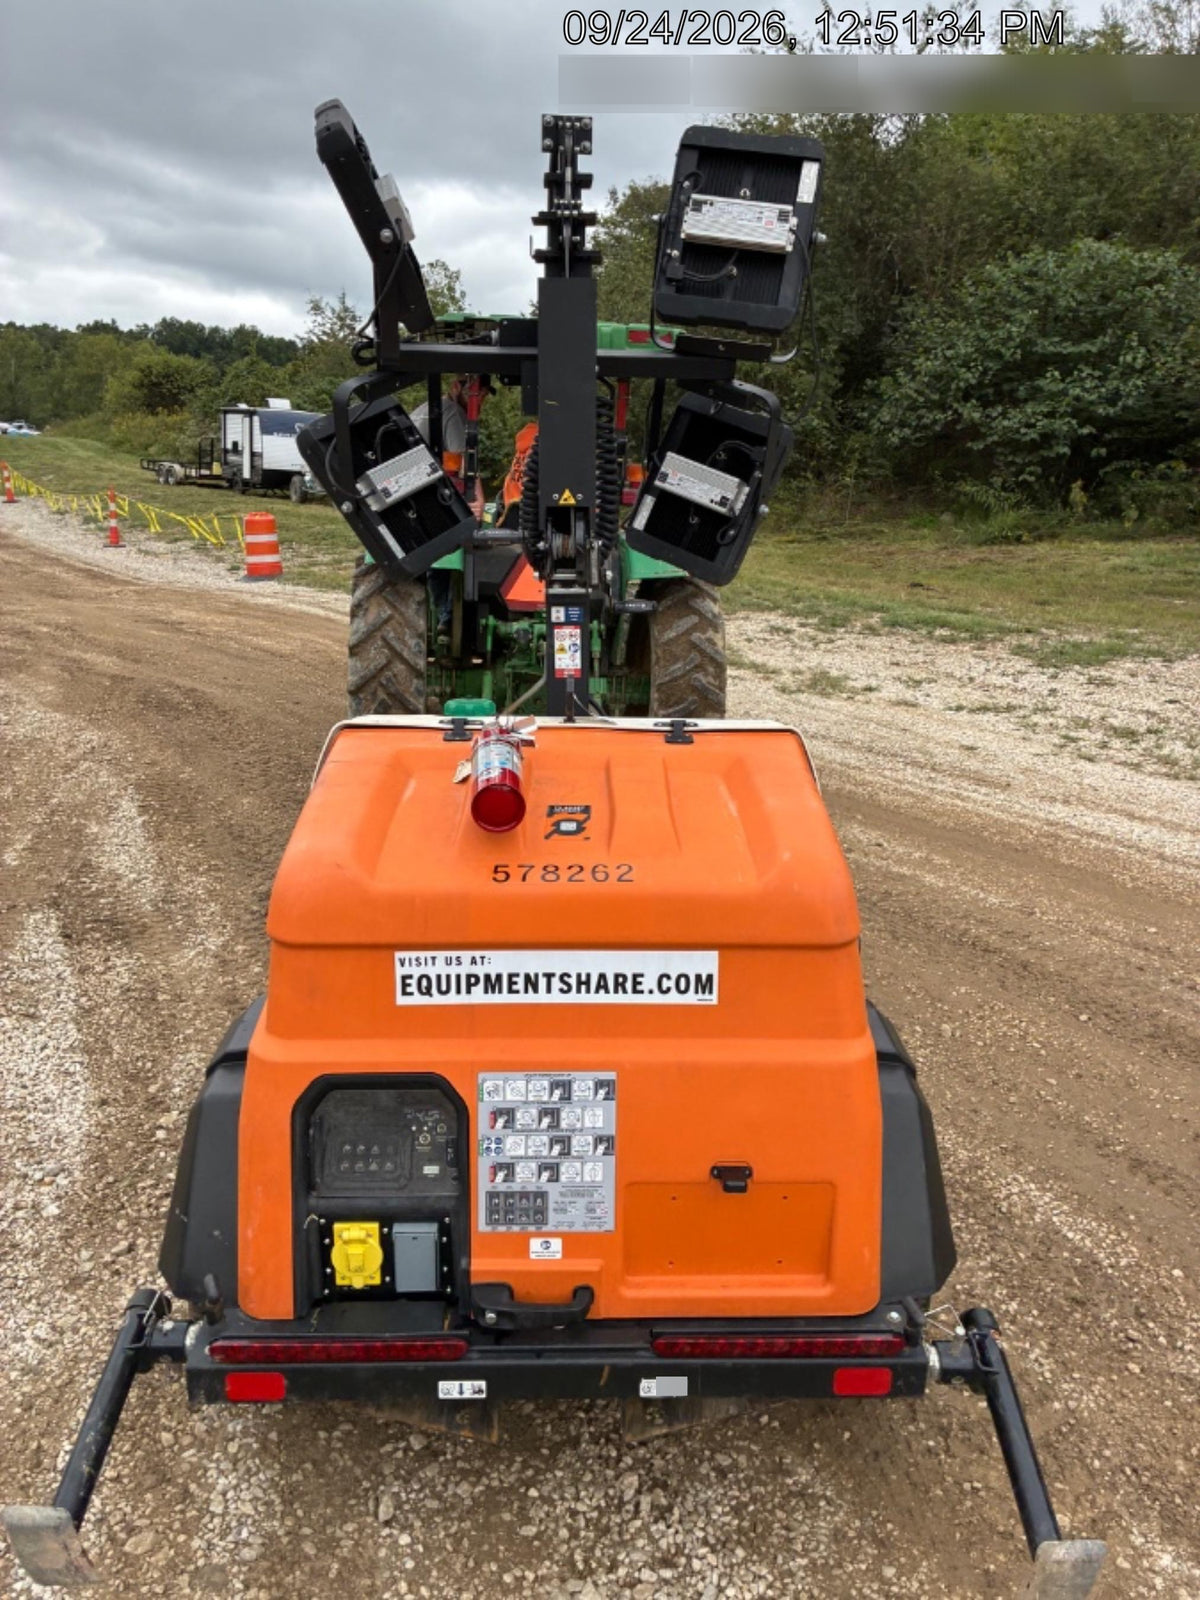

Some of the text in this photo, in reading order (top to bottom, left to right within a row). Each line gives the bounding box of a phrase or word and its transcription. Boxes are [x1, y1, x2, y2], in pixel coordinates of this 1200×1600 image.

[491, 863, 635, 883] 578262
[398, 955, 492, 968] VISIT US AT:
[400, 971, 714, 998] EQUIPMENTSHARE.COM
